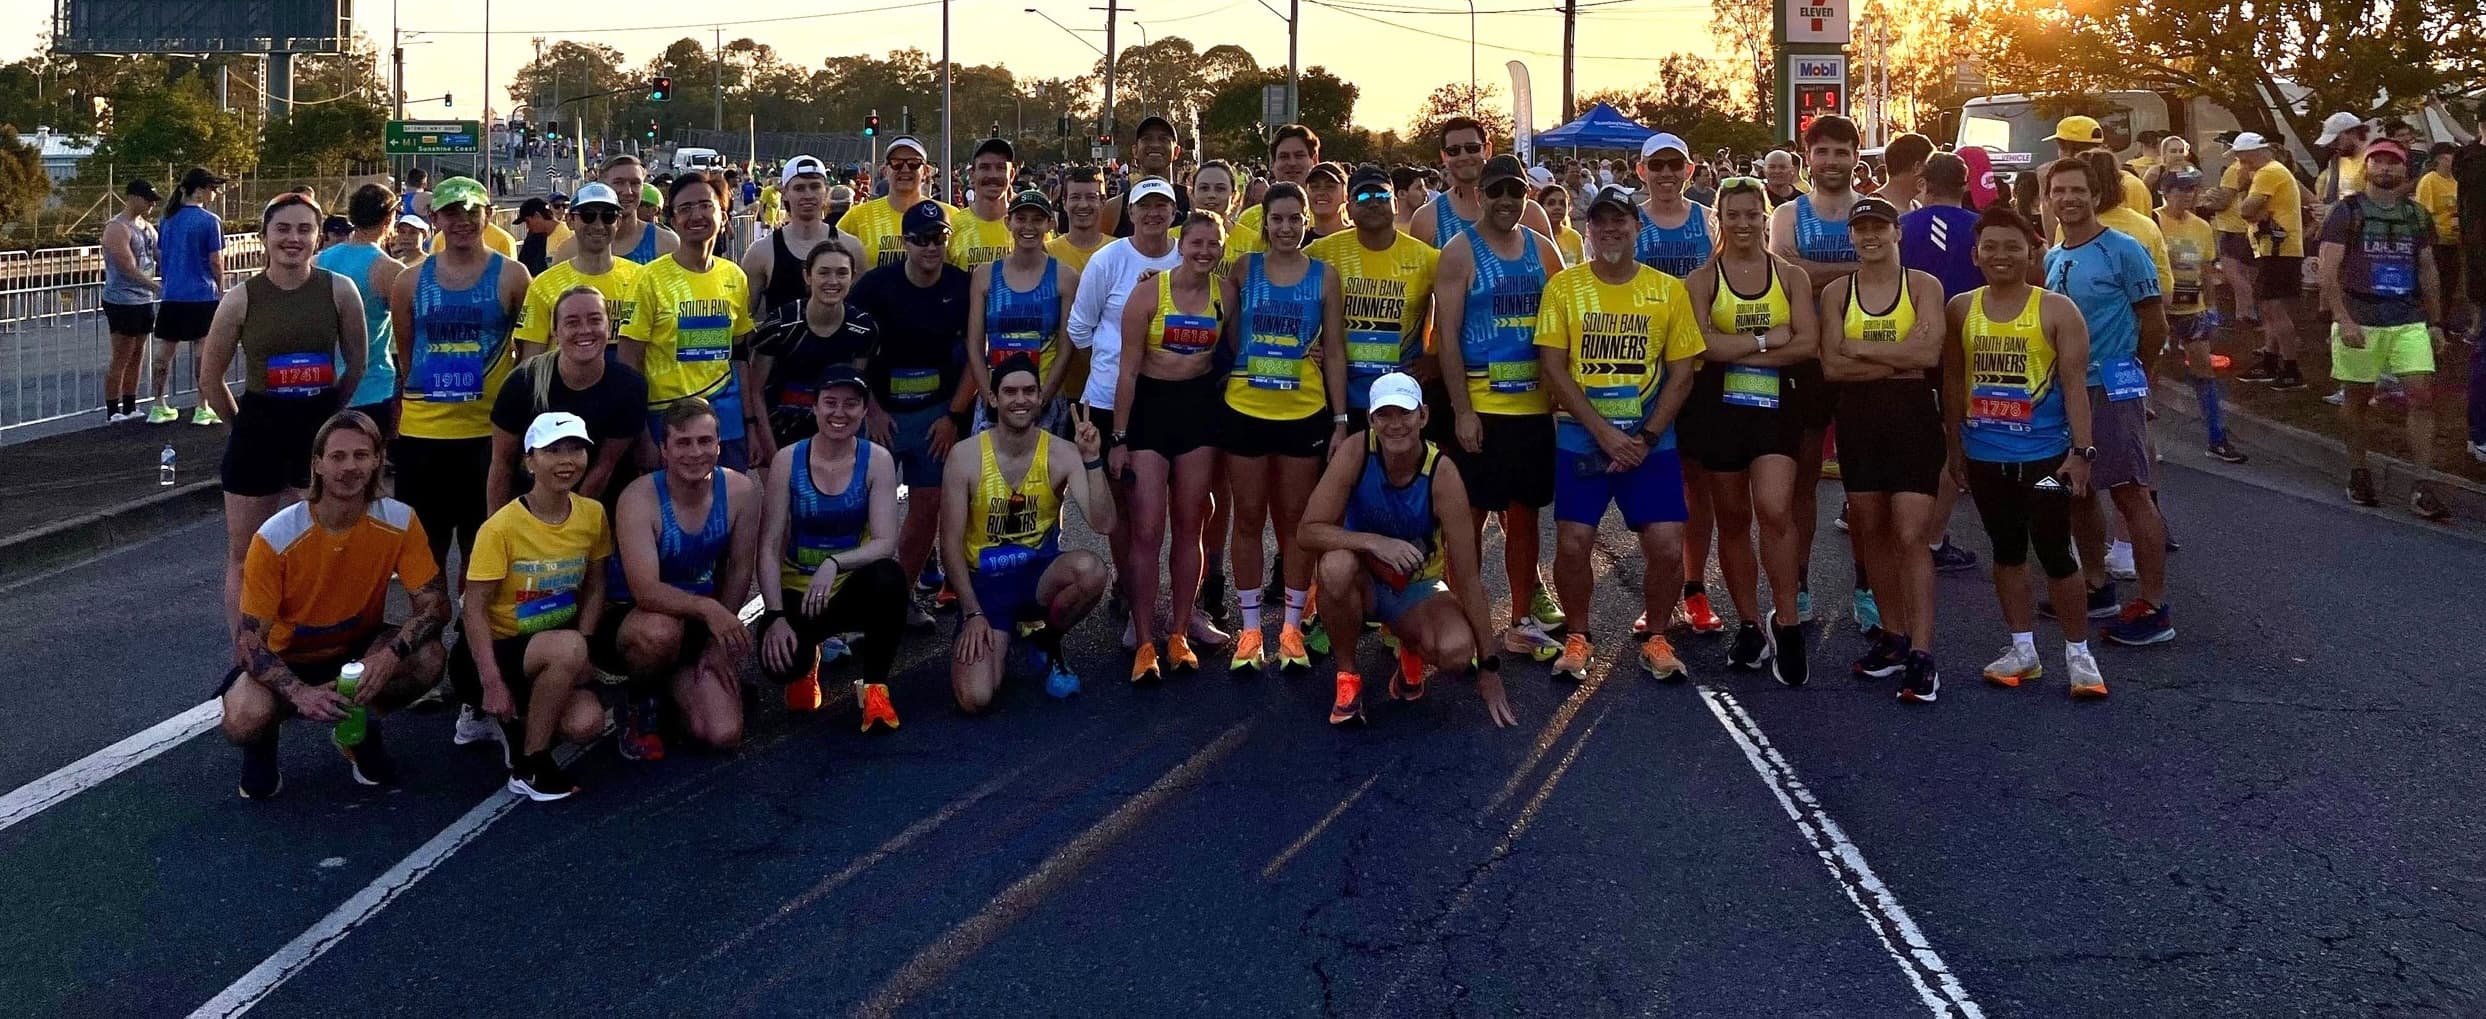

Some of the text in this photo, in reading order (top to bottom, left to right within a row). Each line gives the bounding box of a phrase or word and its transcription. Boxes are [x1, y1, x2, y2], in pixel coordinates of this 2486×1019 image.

[1800, 62, 1837, 76] Mobil
[879, 235, 904, 250] SOUT
[968, 247, 993, 263] SOUTH
[1345, 277, 1407, 298] SOUTH BANK
[679, 299, 708, 317] SOUTH
[1344, 295, 1404, 319] RUNNERS
[1736, 303, 1770, 314] SOUTH BANK
[1252, 314, 1301, 335] RUNNERS
[1582, 312, 1652, 335] SOUTH BANK
[1735, 313, 1771, 328] RUNNERS
[1863, 319, 1897, 329] SOUTH BANK
[1862, 330, 1897, 342] RUNNERS
[1973, 335, 2029, 353] SOUTH BANK
[1581, 334, 1648, 360] RUNNERS
[1973, 353, 2027, 373] RUNNERS
[279, 366, 320, 384] 1741
[433, 372, 475, 388] 1910
[1981, 400, 2022, 417] 1778
